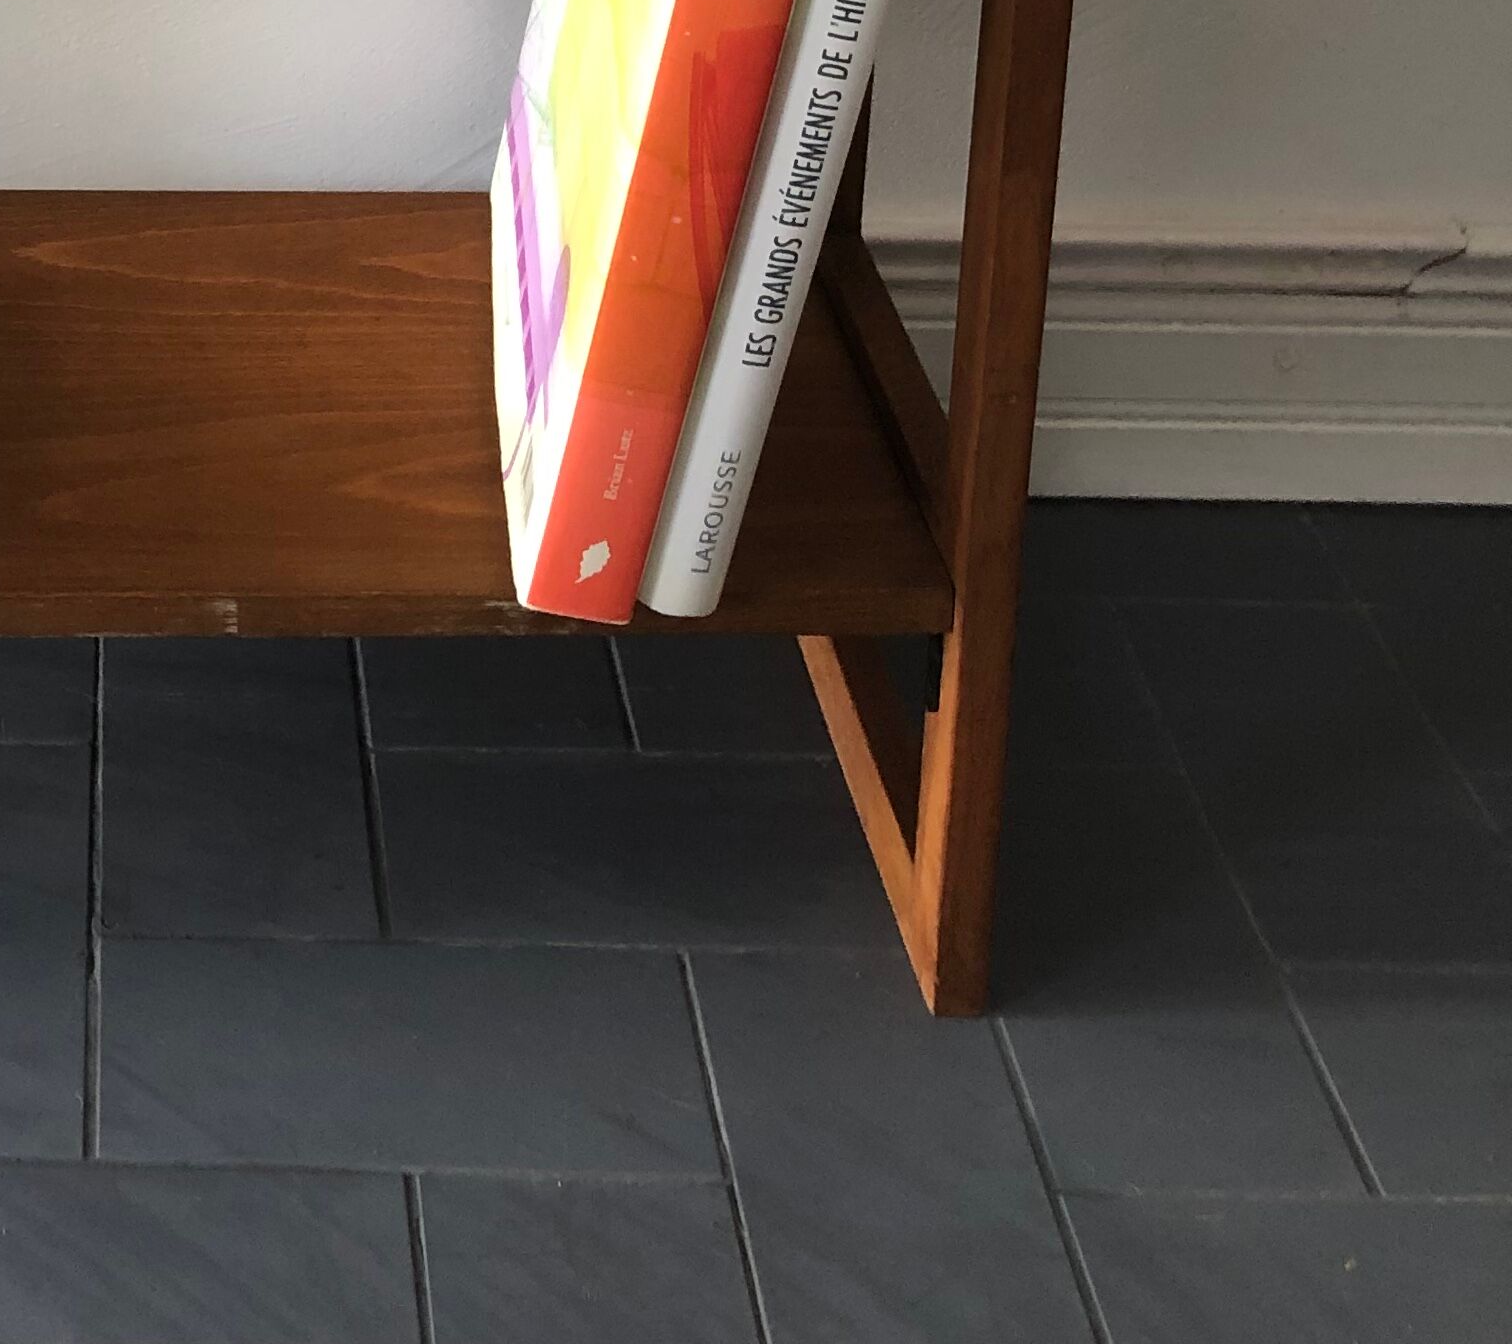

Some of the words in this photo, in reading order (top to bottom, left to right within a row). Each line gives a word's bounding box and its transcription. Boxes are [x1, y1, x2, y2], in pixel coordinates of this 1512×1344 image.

[817, 48, 853, 81] DE
[772, 87, 843, 229] ÉVÉNEMENTS
[753, 235, 804, 325] GRANDS
[741, 331, 777, 369] LES
[603, 460, 625, 501] Brian
[691, 450, 742, 574] LAROUSSE
